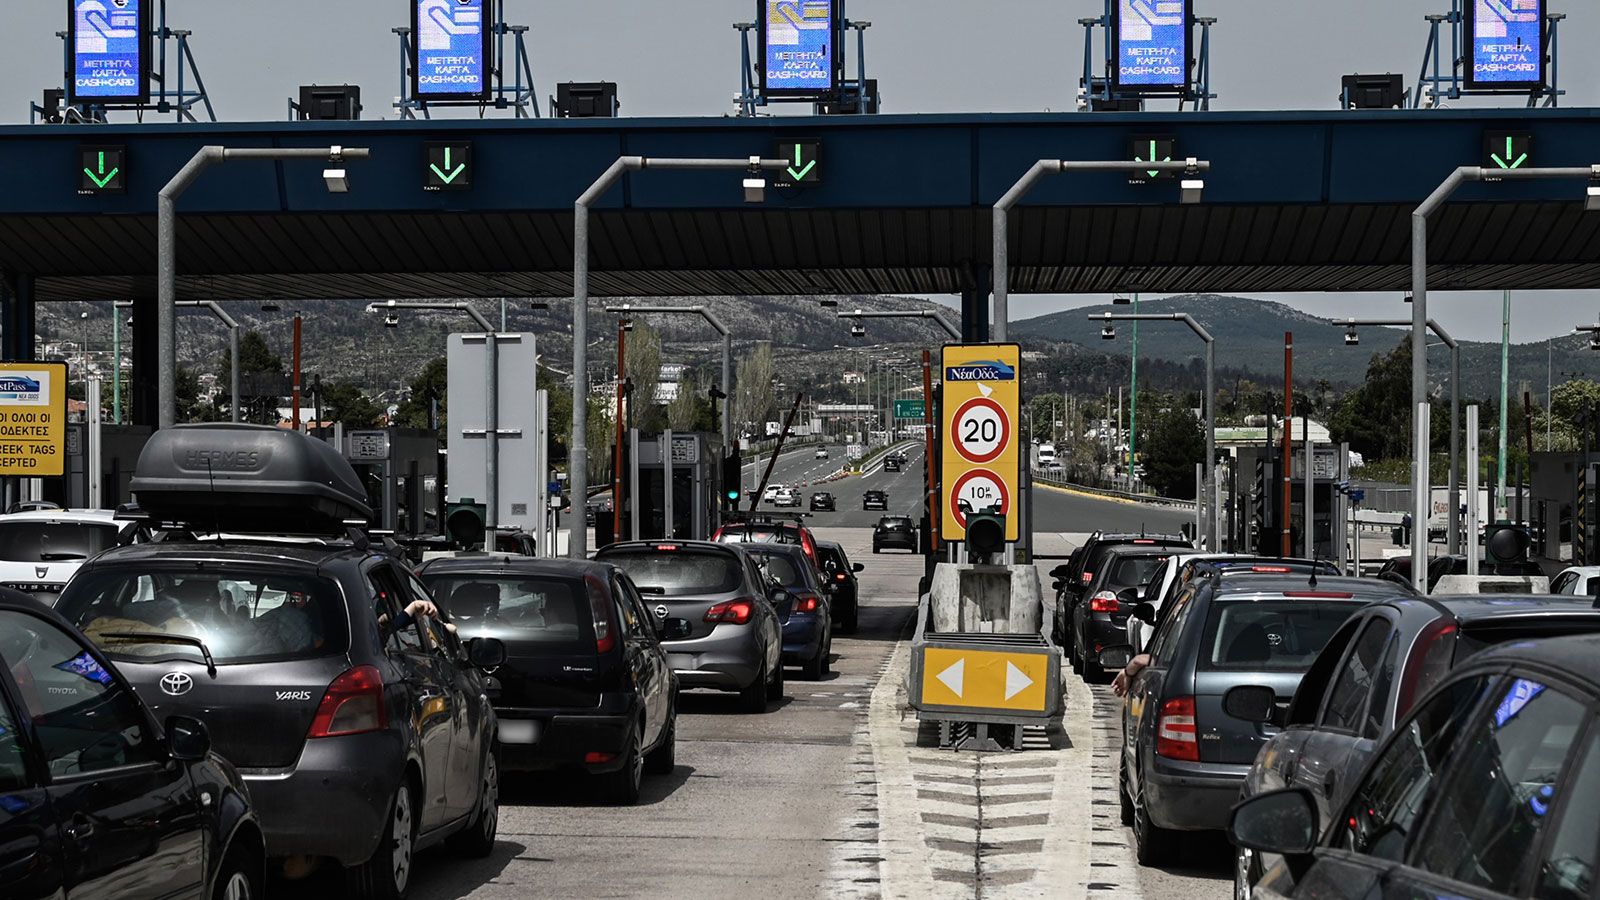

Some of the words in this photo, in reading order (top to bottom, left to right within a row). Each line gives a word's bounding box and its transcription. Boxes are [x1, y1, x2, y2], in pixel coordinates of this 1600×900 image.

[951, 368, 999, 381] ΝέαΟδός
[12, 413, 36, 422] ΟΛΟΙ
[40, 414, 50, 422] ΟΙ
[964, 418, 997, 442] 20
[0, 445, 23, 454] EEK
[29, 445, 56, 454] TAGS
[0, 458, 37, 467] EPTED
[184, 450, 259, 468] HERMES
[971, 487, 985, 498] 10
[47, 687, 78, 695] TOYOTA
[275, 690, 312, 701] YARIS
